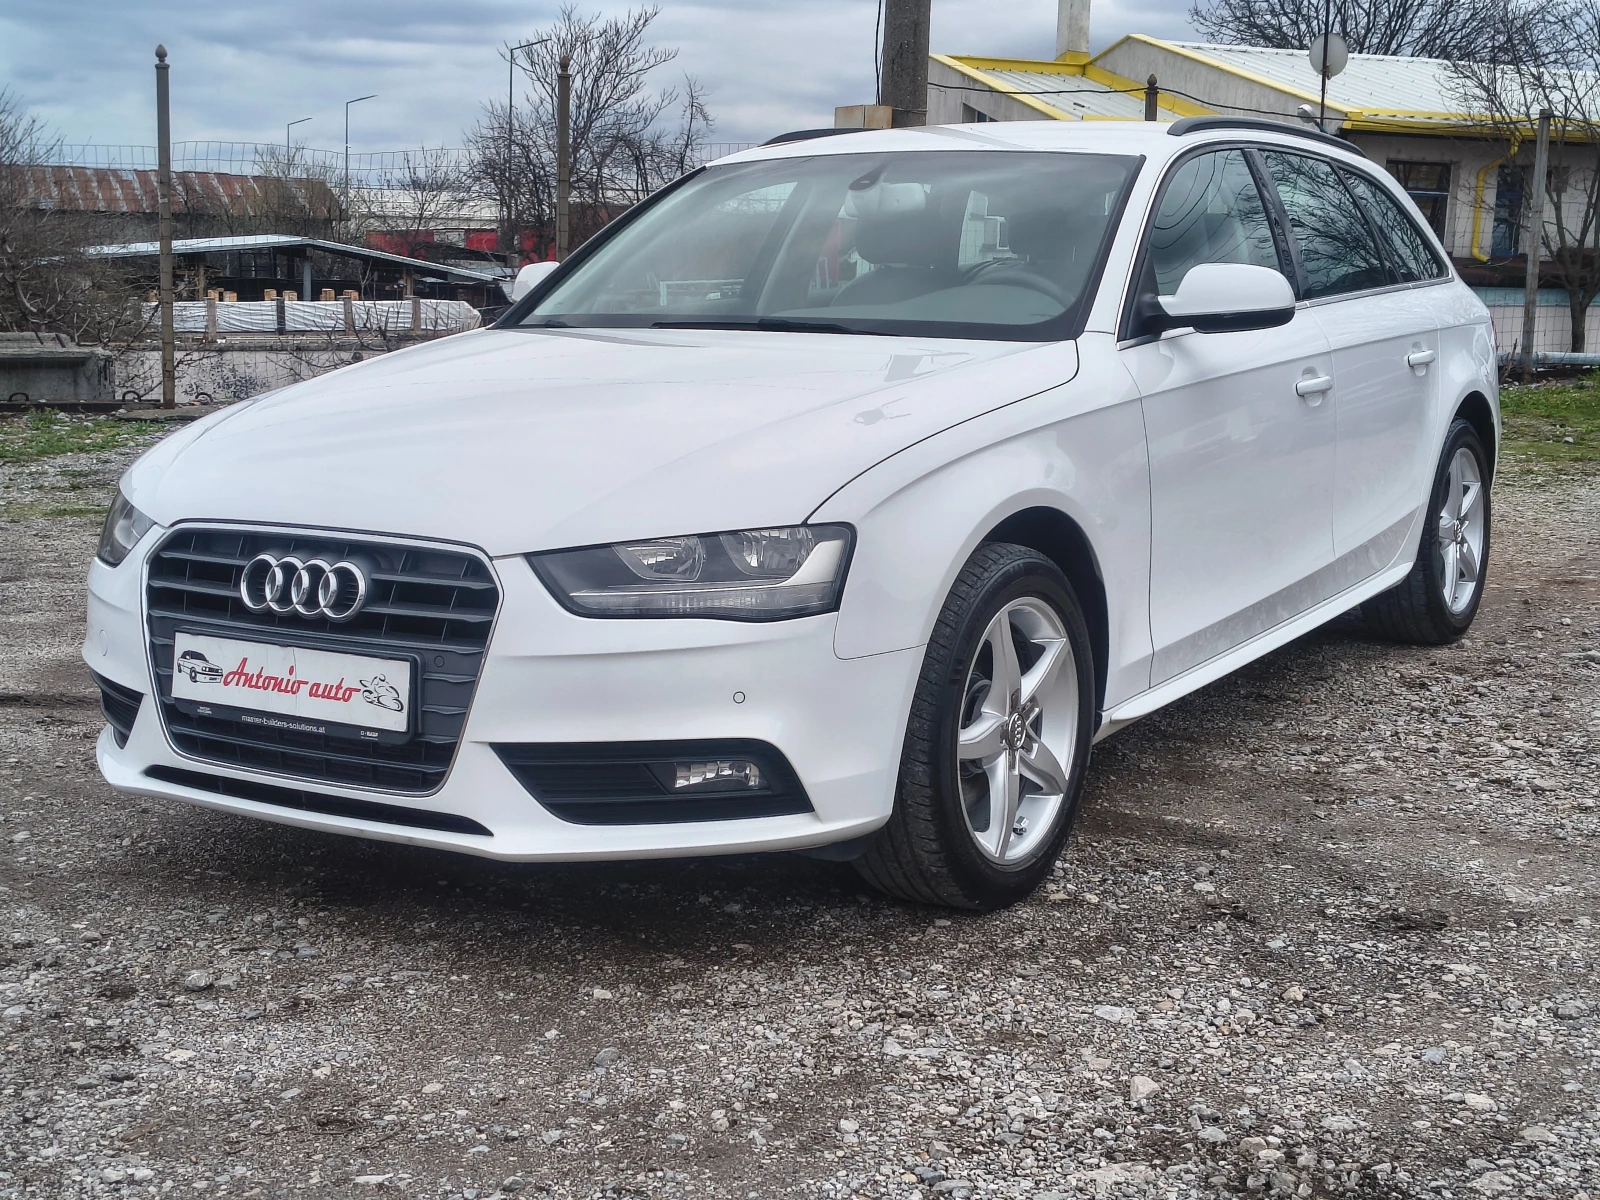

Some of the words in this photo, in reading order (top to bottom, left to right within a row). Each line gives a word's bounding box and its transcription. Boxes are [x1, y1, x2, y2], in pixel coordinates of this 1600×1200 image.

[223, 657, 308, 694] Antonio
[308, 677, 361, 702] auto
[241, 715, 326, 733] master-builders-solutions.at
